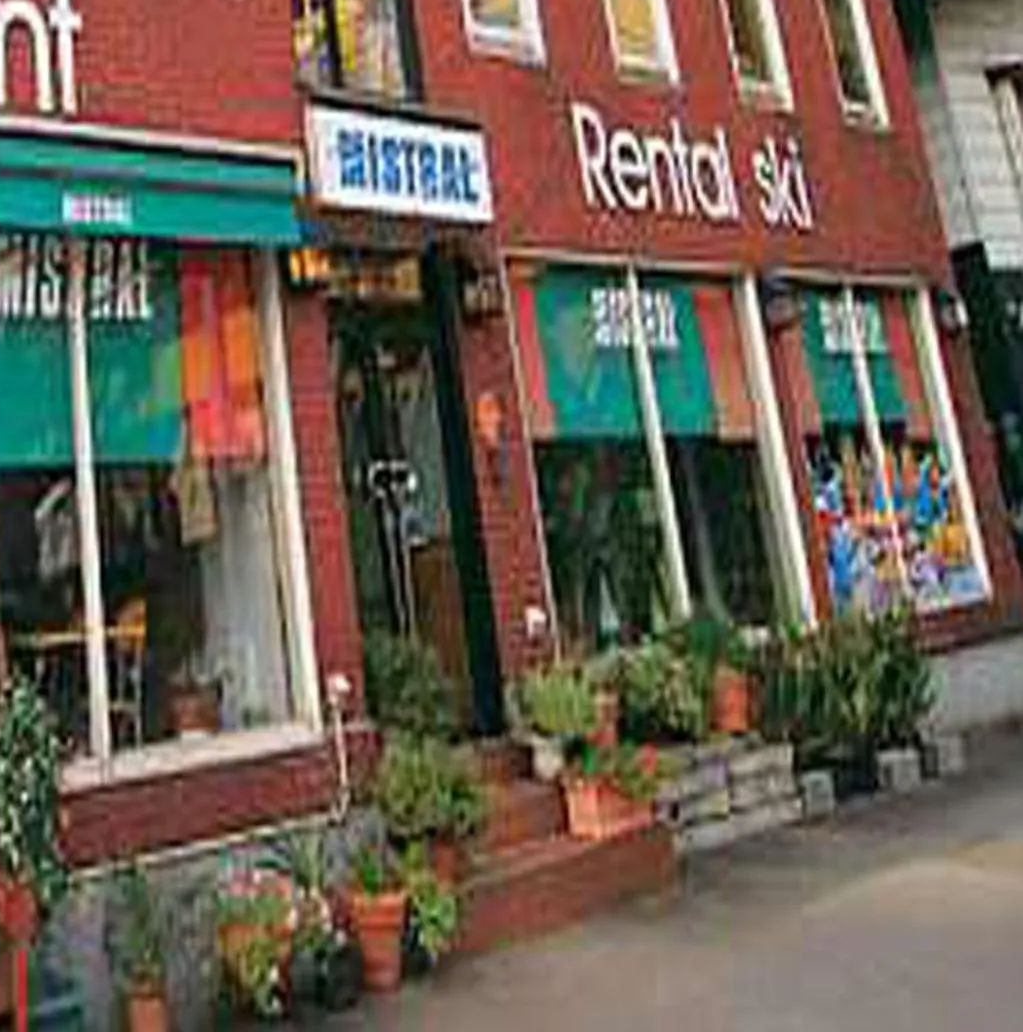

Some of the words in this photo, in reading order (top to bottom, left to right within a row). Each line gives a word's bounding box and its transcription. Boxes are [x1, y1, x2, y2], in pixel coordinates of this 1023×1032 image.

[338, 127, 480, 203] MISTRAL
[570, 101, 740, 220] Rental
[752, 135, 813, 229] ski
